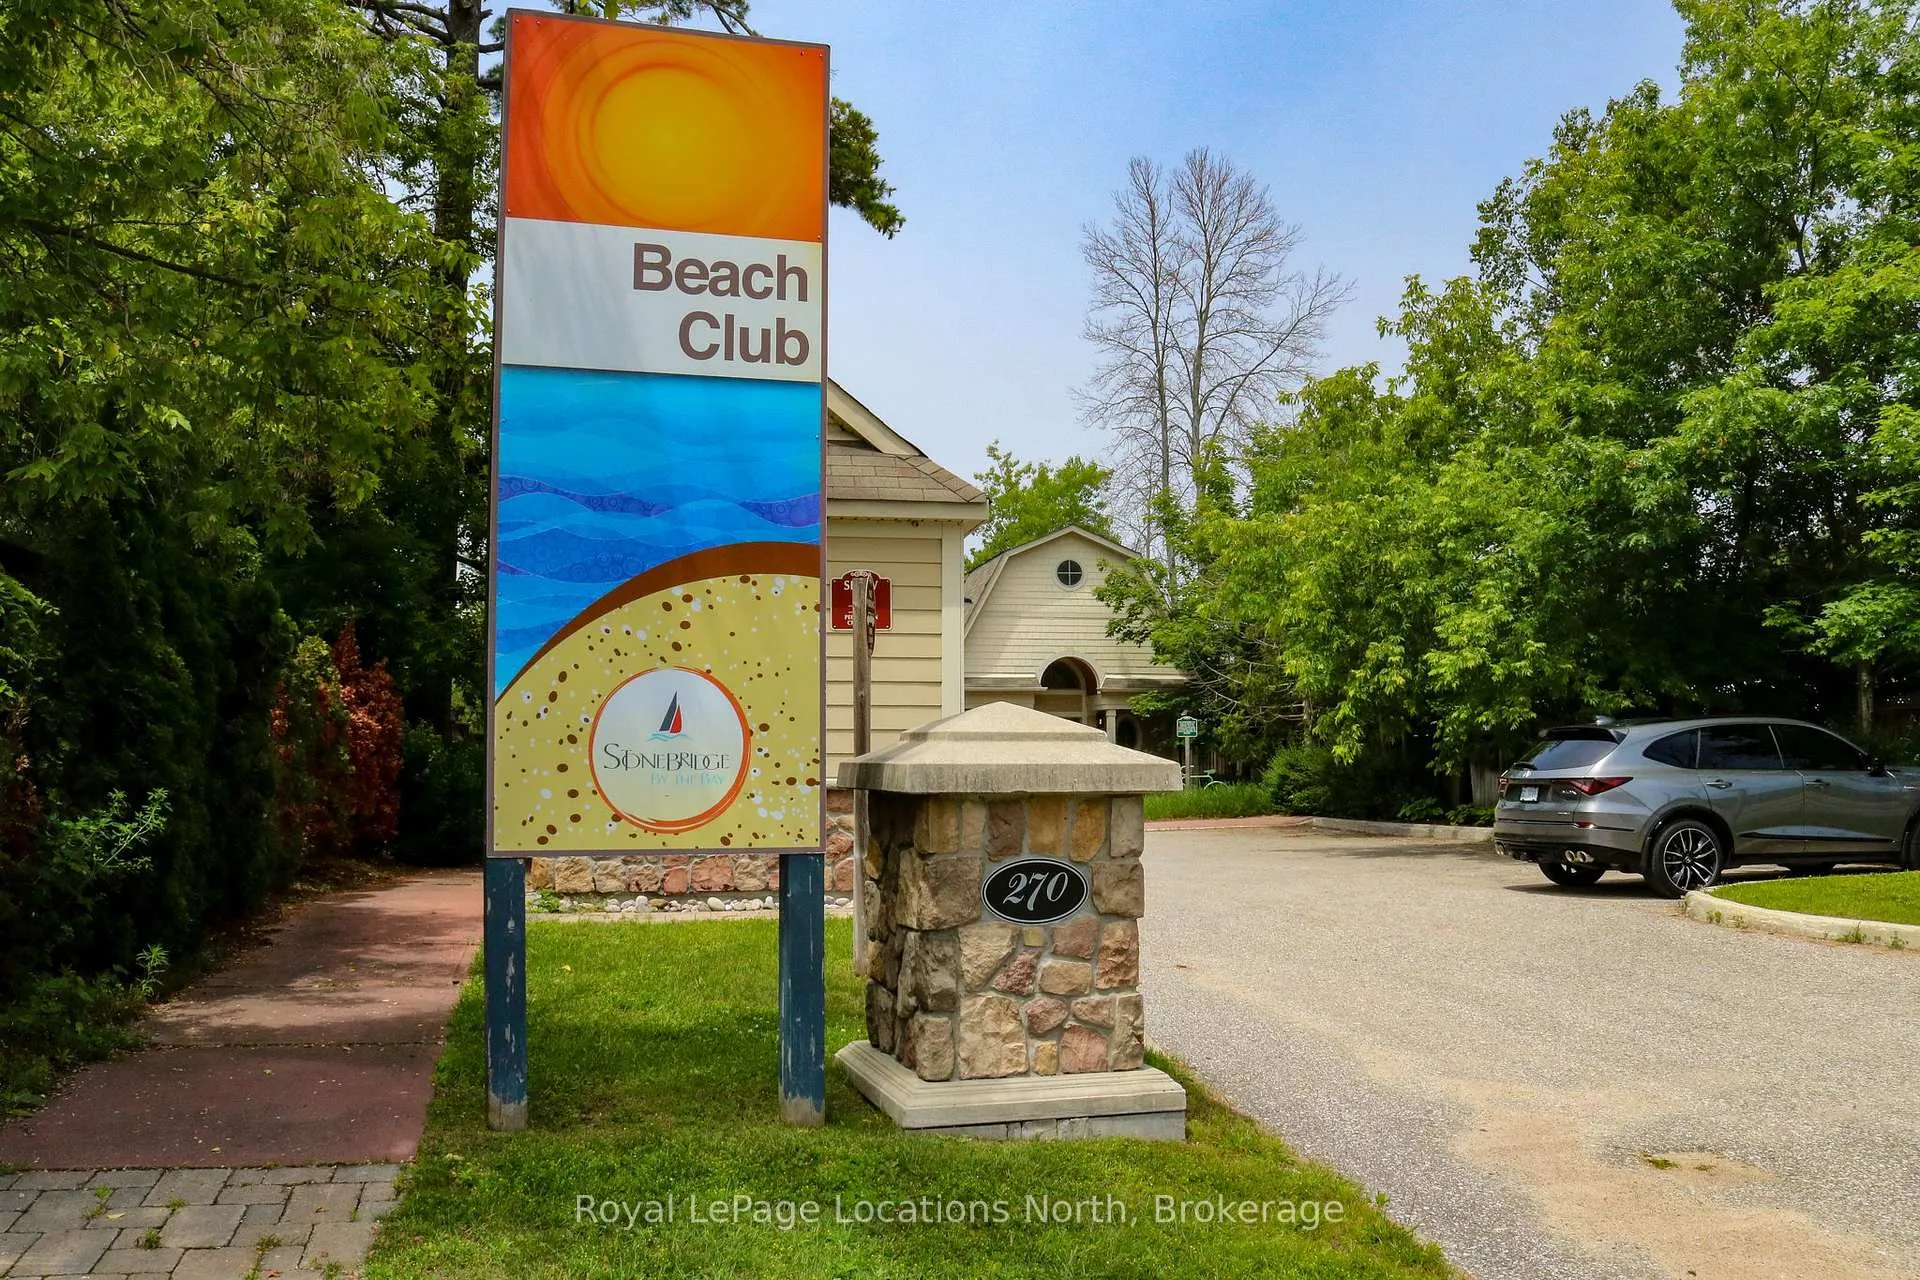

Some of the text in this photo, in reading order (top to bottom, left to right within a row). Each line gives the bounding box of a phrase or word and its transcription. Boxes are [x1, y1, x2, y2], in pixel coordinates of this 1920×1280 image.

[633, 242, 808, 302] Beach
[679, 311, 810, 366] Club
[1003, 872, 1068, 911] 270
